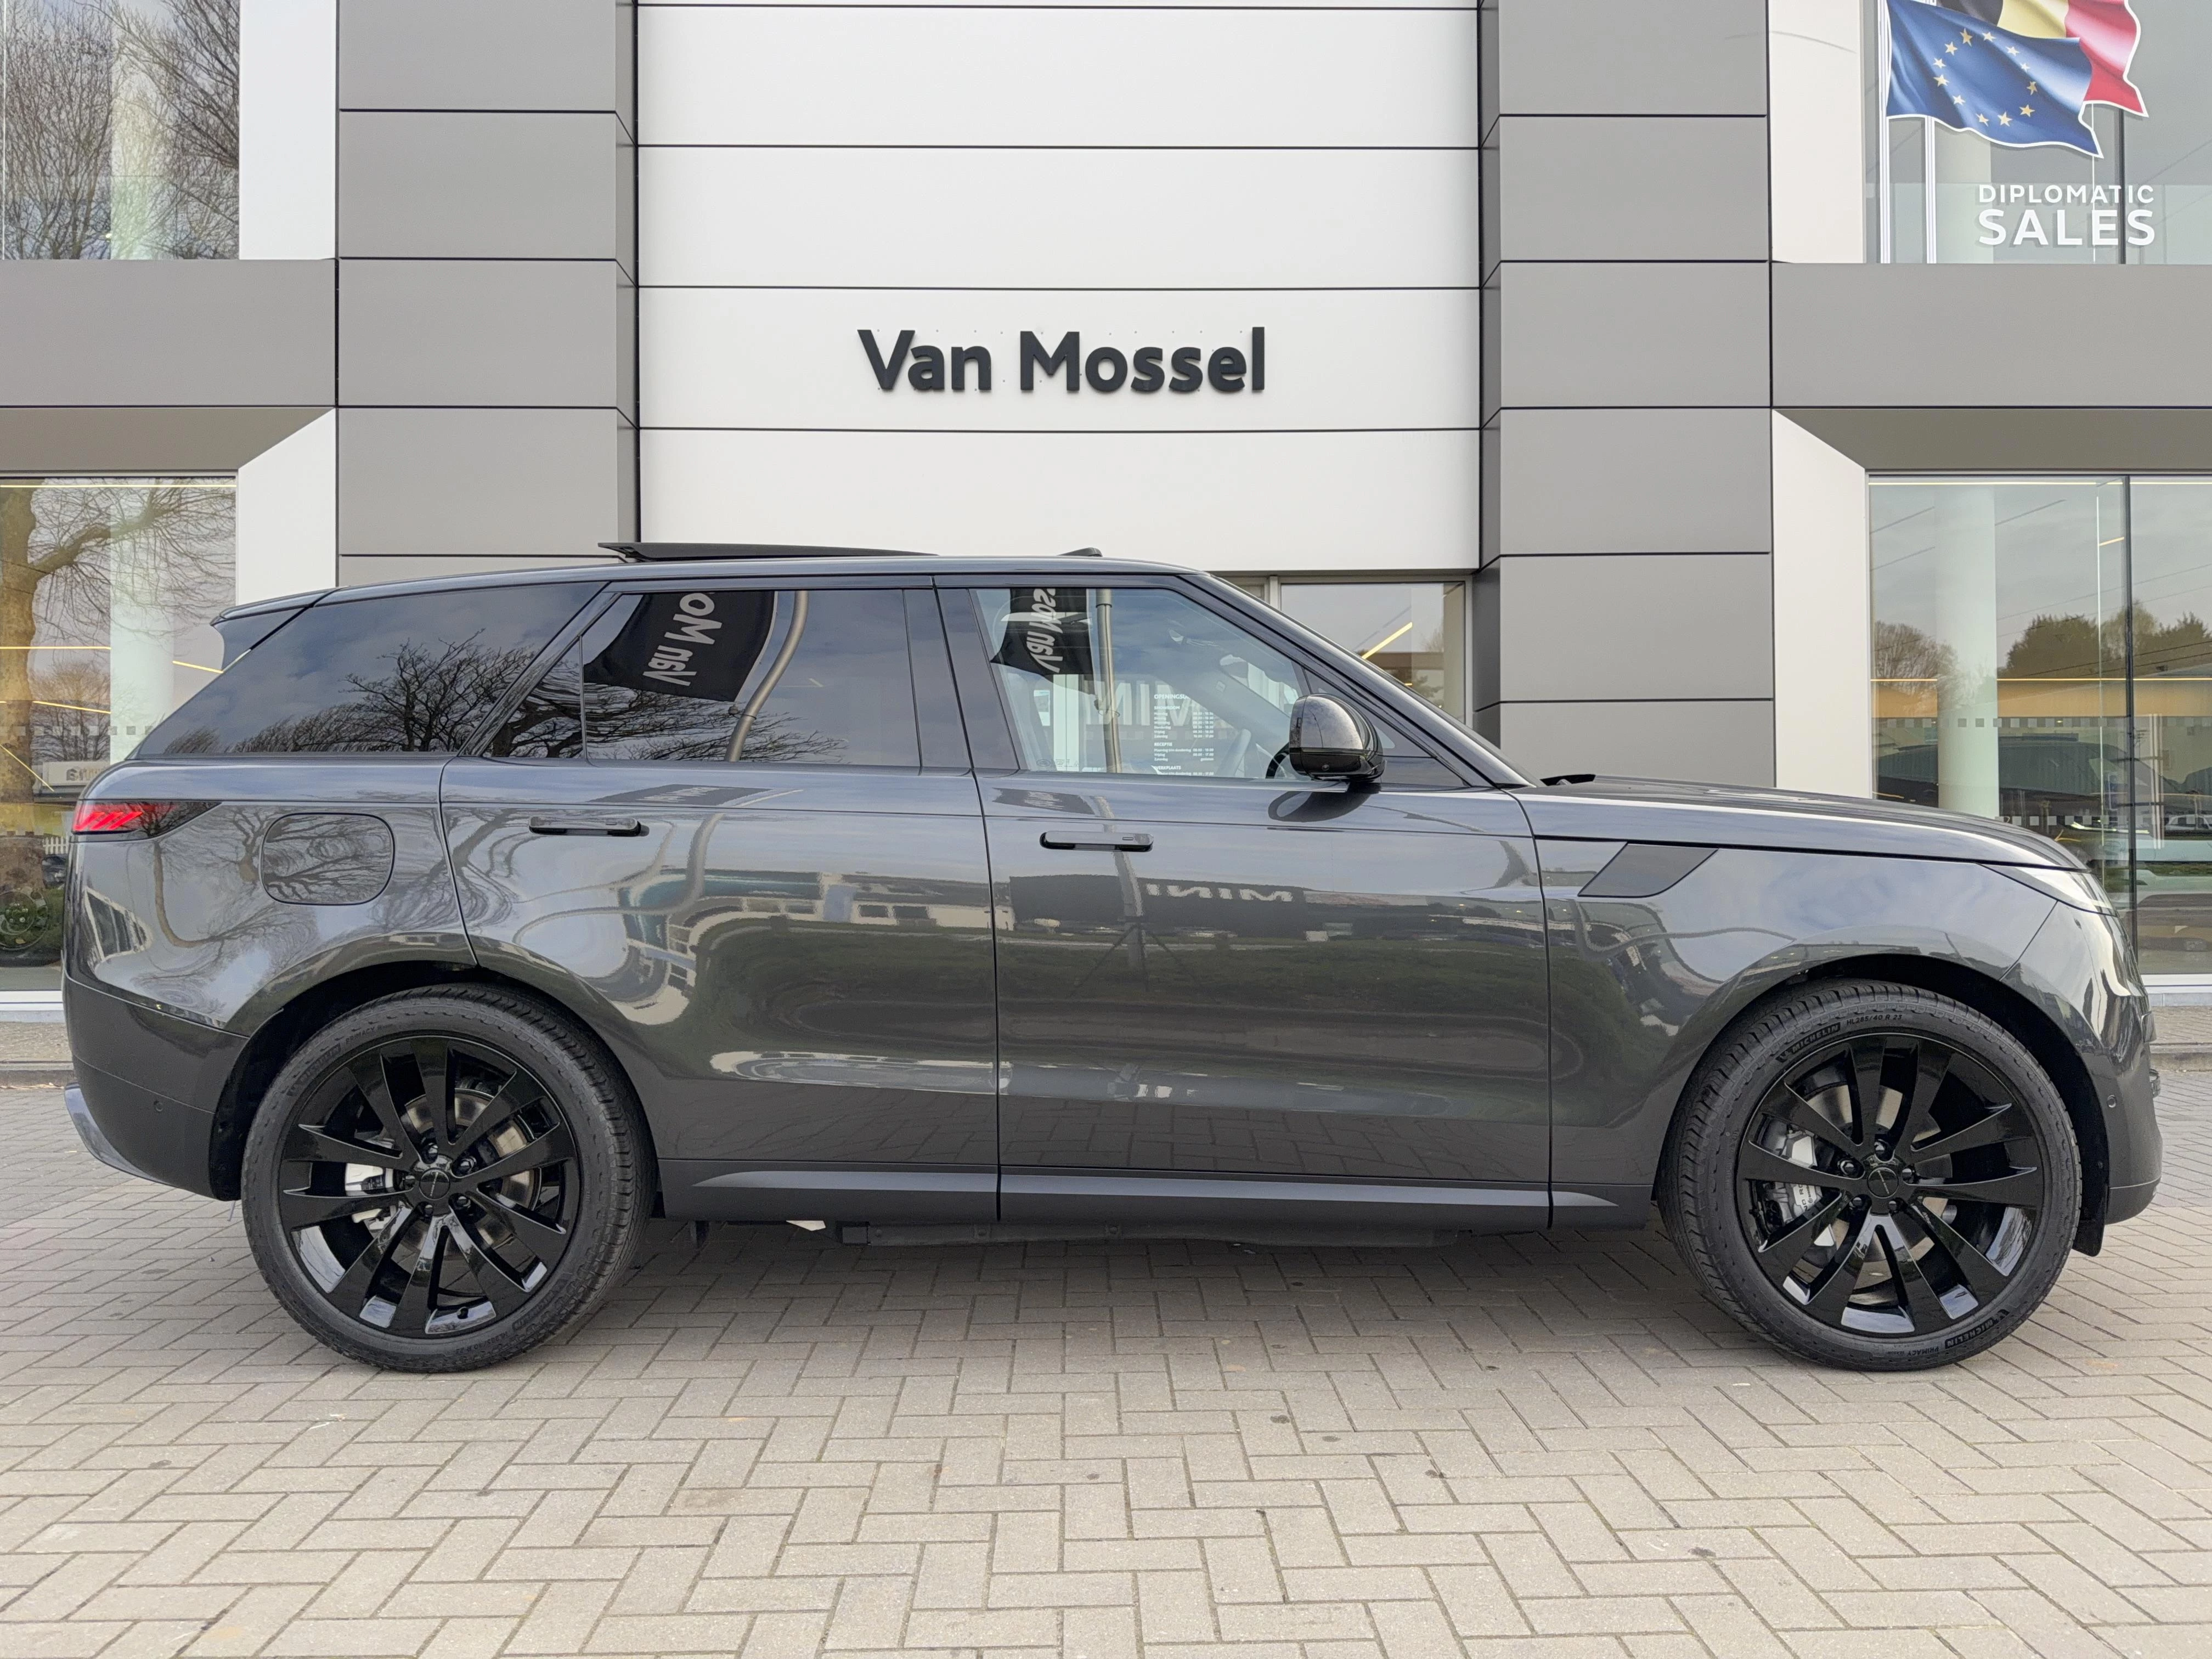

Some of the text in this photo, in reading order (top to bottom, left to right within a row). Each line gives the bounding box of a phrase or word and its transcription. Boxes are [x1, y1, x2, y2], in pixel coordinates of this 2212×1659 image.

[1978, 184, 2155, 204] DIPLOMATIC
[1978, 208, 2155, 246] SALES
[856, 326, 1266, 393] Van Mossel
[1791, 1024, 1840, 1055] MICHELIN
[1946, 1318, 1995, 1349] MICHELIN
